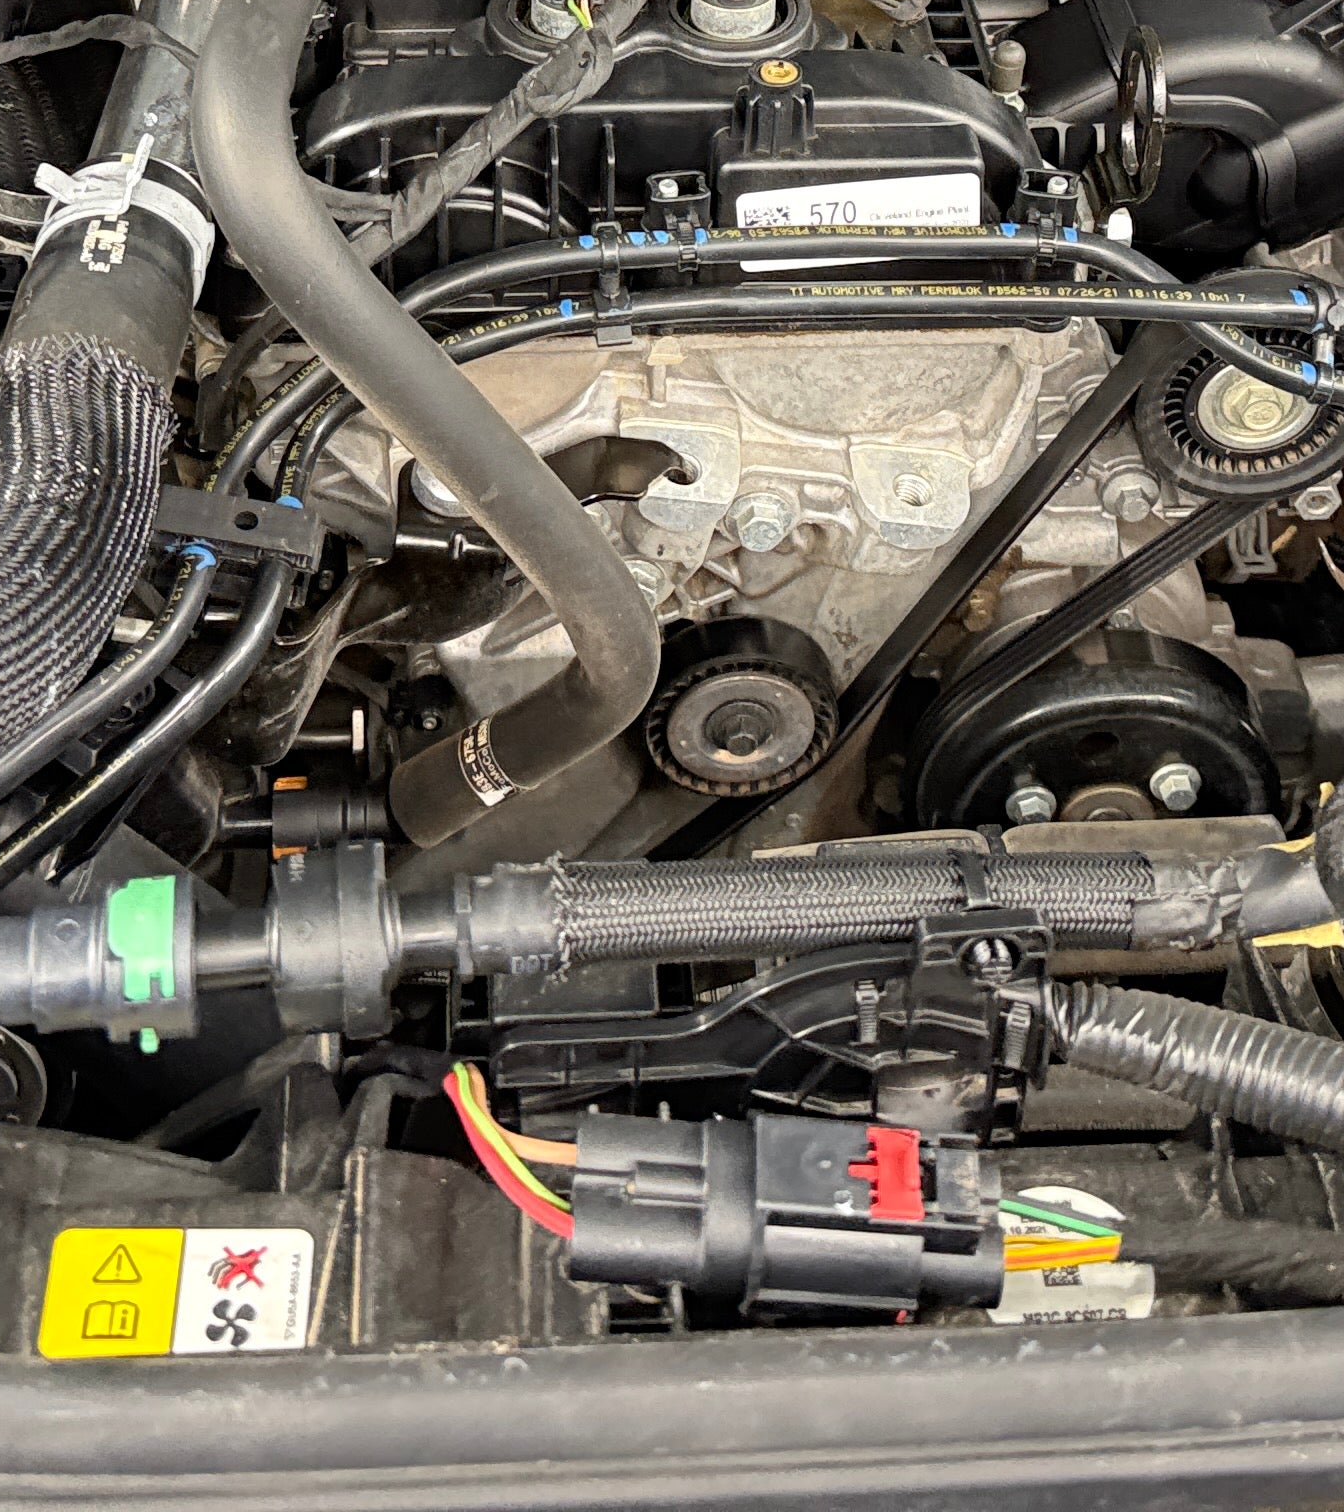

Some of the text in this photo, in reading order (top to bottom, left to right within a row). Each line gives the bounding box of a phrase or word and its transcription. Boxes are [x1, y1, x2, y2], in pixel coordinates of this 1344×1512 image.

[809, 200, 857, 225] 570
[811, 286, 886, 297] AUTOMOTIVE
[920, 286, 983, 296] PERMBLOK
[1057, 288, 1118, 298] 07/26/21
[1128, 289, 1192, 300] 18:16:39
